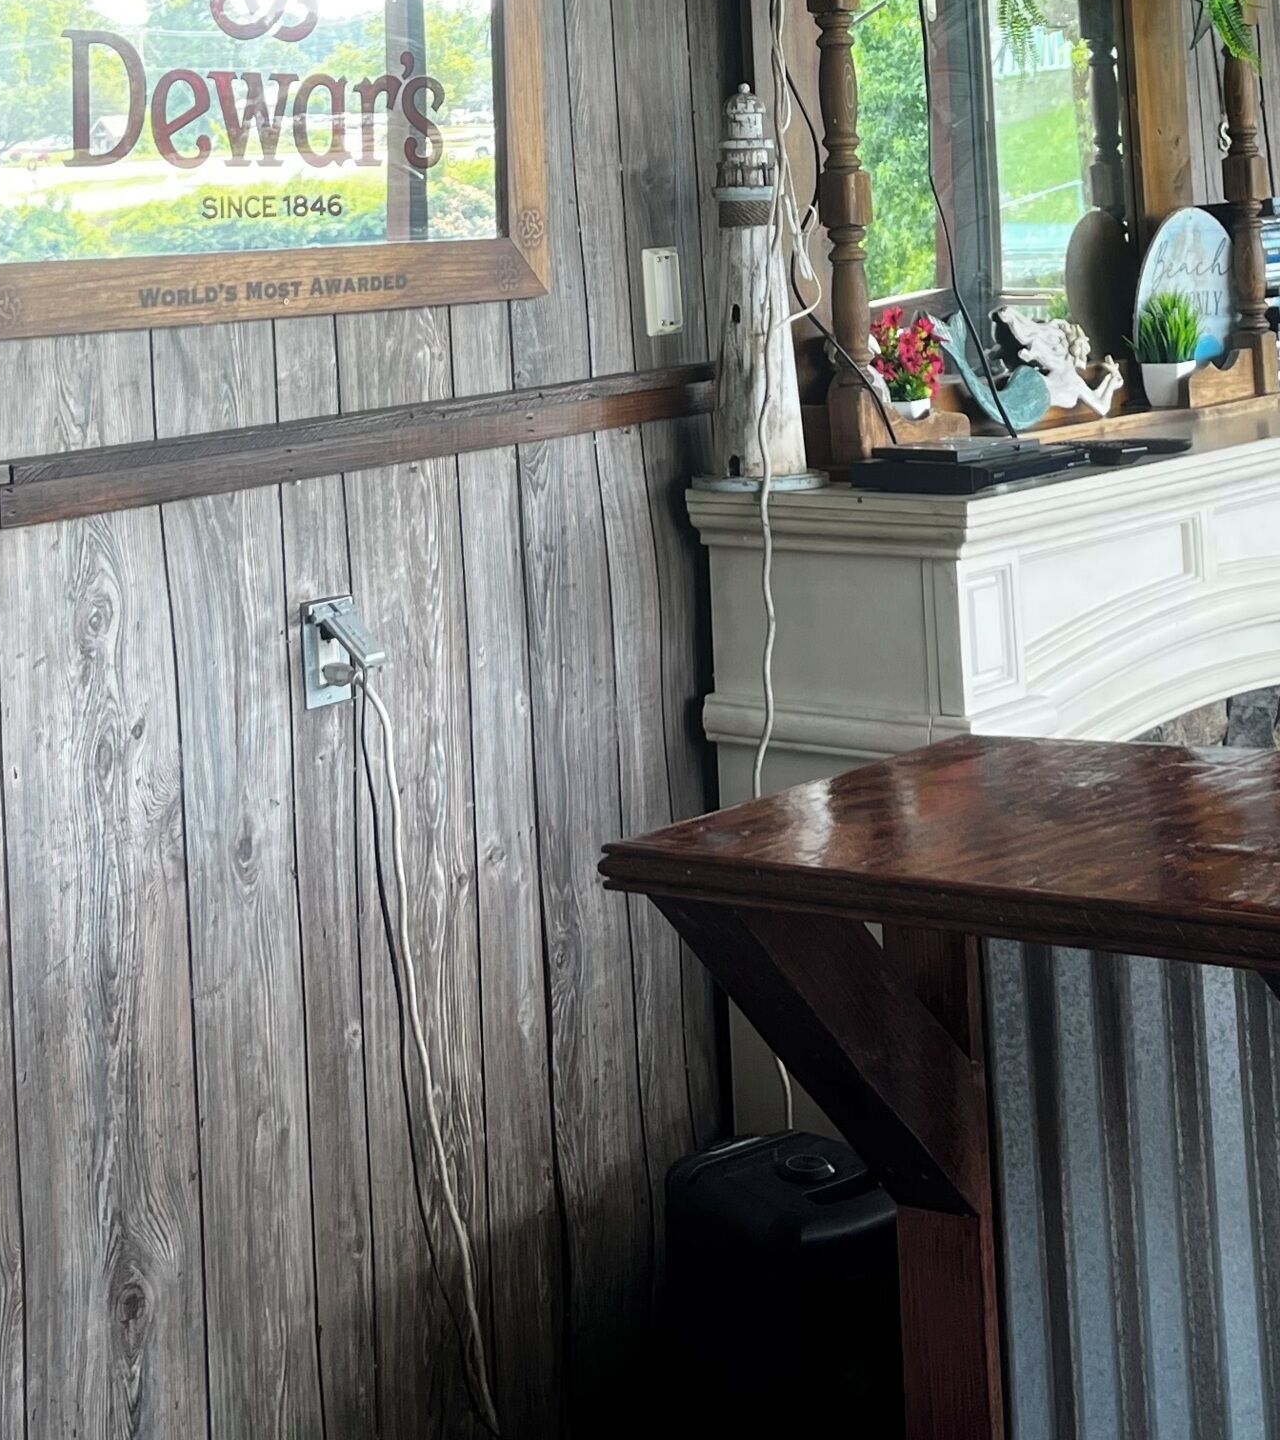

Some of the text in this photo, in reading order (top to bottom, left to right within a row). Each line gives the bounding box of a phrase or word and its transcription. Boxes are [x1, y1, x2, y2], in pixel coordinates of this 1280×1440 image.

[61, 29, 446, 170] Dewar's
[201, 193, 343, 220] SINCE 1846
[1152, 237, 1231, 291] Beach
[138, 274, 408, 309] WORLD'S MOST AWARDED
